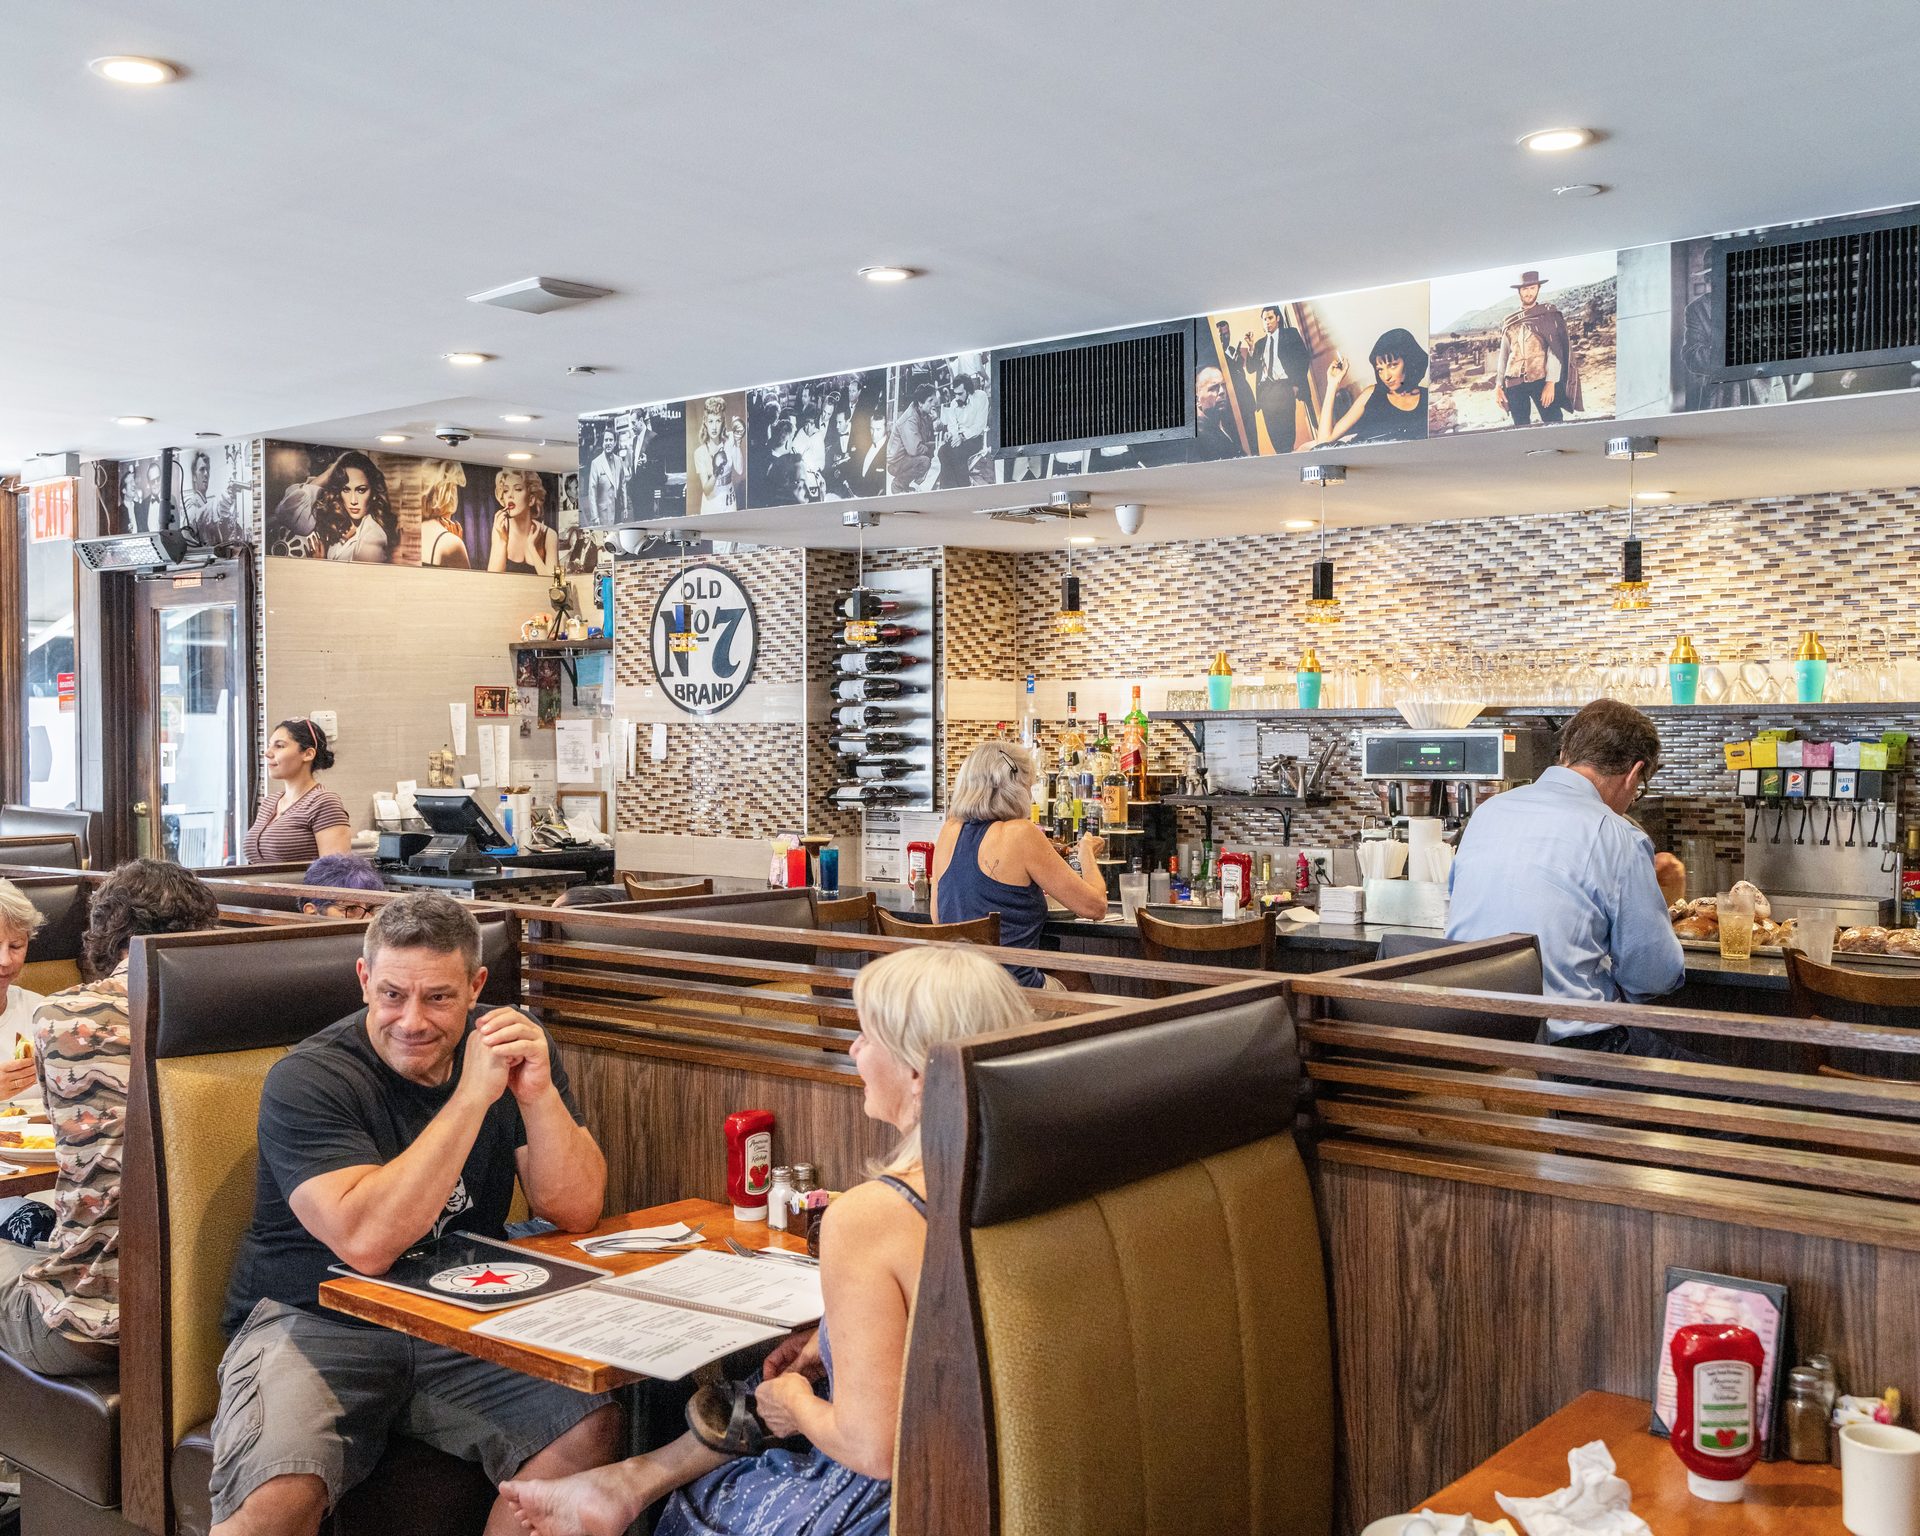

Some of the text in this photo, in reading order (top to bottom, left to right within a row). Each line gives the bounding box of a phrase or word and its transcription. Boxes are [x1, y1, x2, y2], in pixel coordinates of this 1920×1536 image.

[34, 481, 66, 538] EXIT
[681, 577, 722, 600] OLD
[674, 683, 734, 706] BRAND
[432, 1263, 490, 1283] DINER
[449, 1267, 546, 1294] HOLLYWOOD
